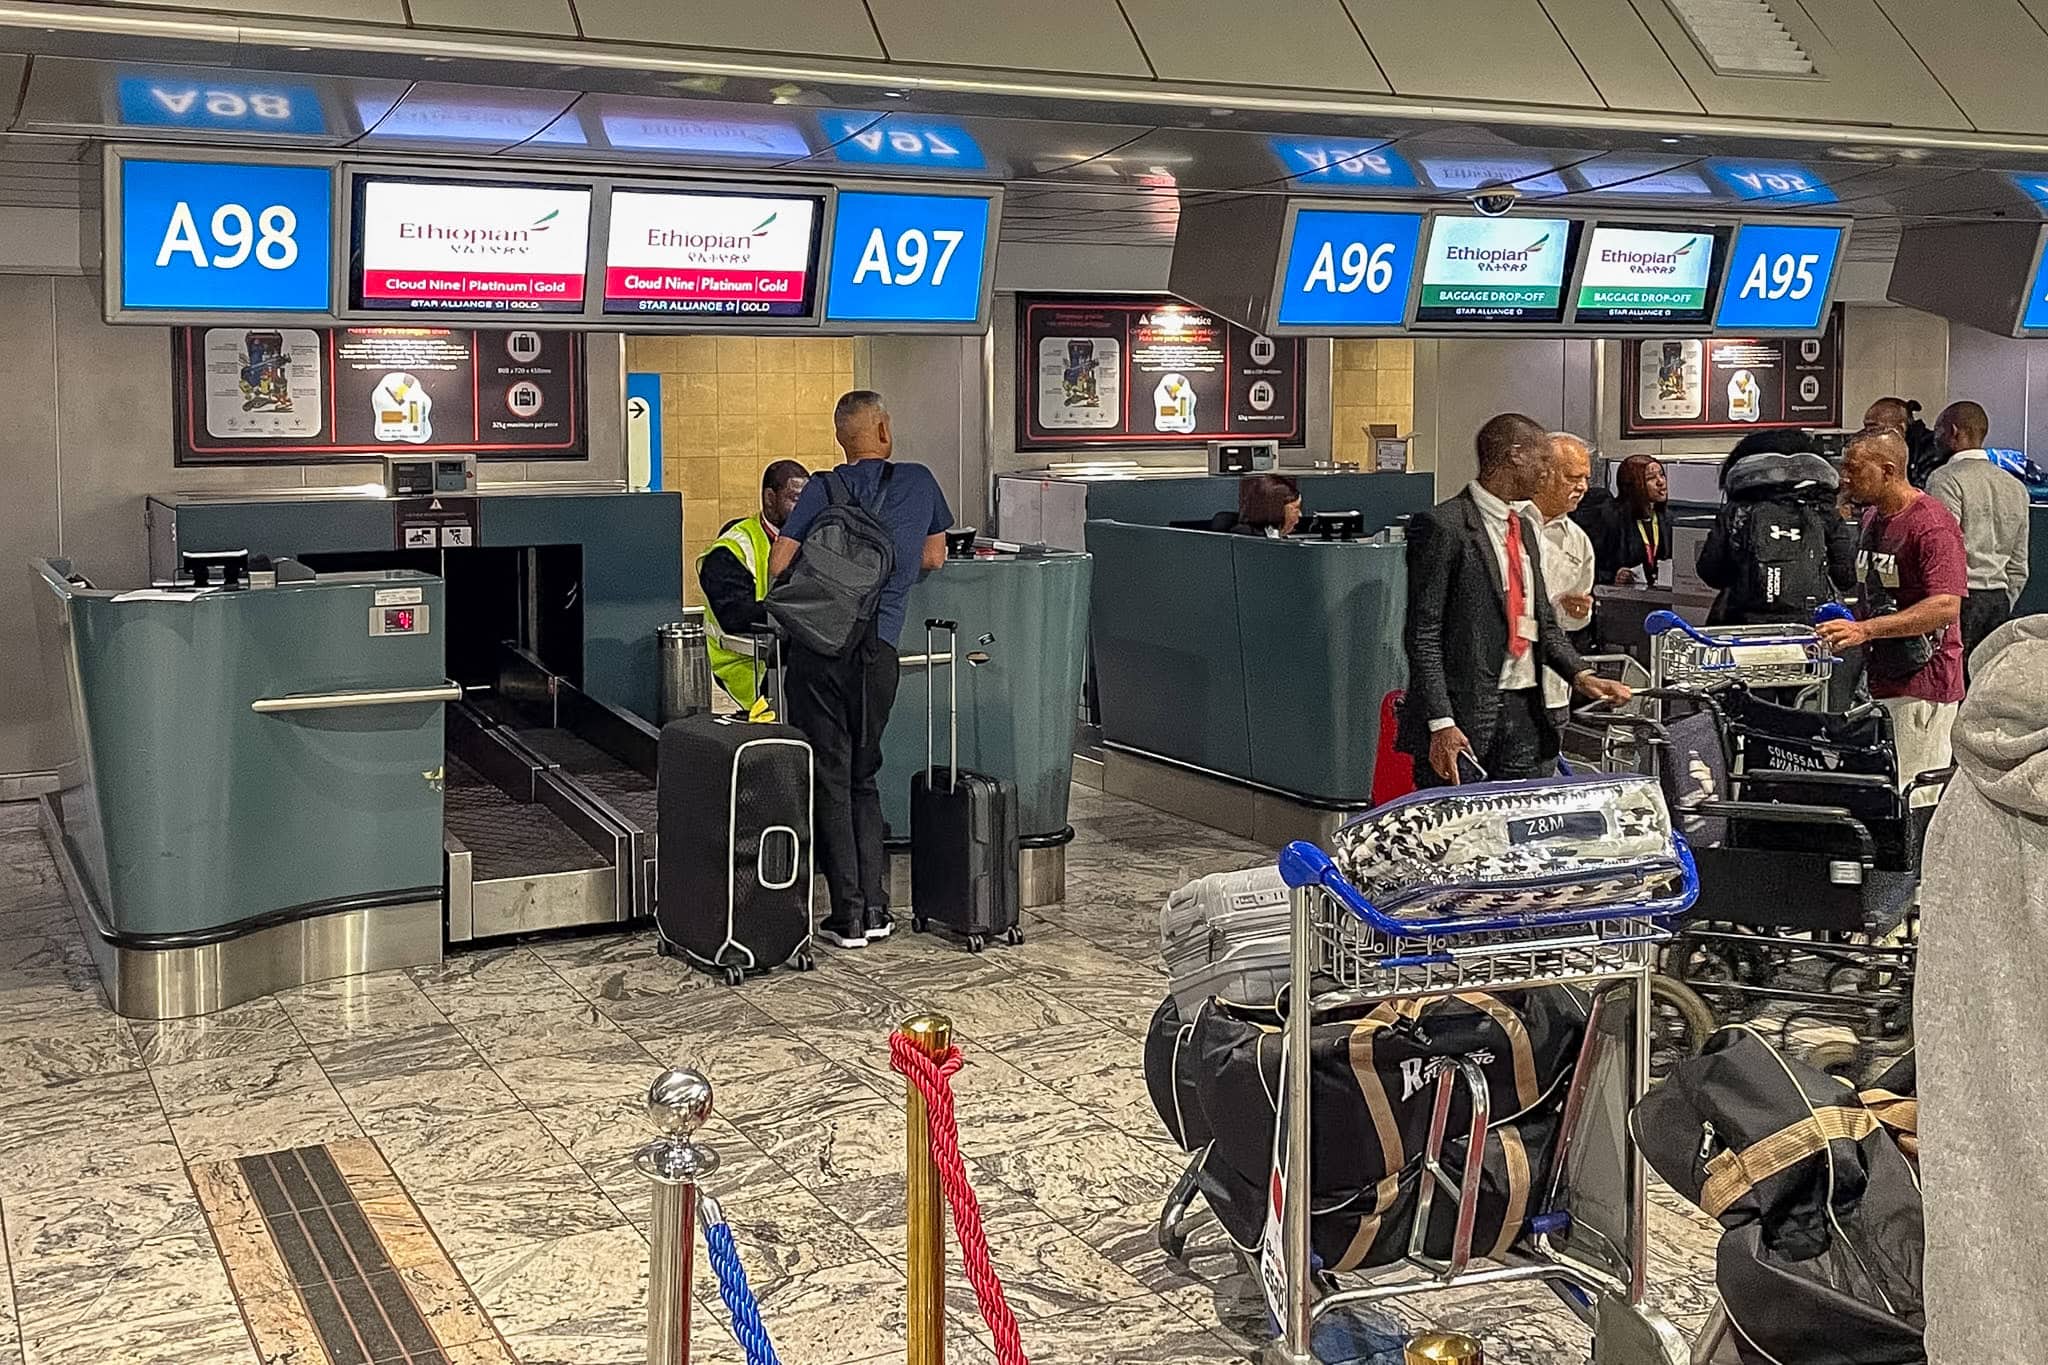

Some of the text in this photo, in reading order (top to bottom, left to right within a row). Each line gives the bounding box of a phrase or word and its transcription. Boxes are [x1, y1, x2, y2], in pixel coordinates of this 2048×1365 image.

[156, 201, 298, 270] A98
[399, 222, 529, 244] Ethiopian
[647, 228, 751, 252] Ethiopian
[852, 226, 965, 286] A97
[1446, 246, 1528, 262] Ethiopian
[1601, 249, 1677, 266] Ethiopian
[1303, 240, 1396, 294] A96
[1738, 252, 1820, 301] A95
[385, 278, 566, 292] Cloud Nine Platinum Gold
[624, 275, 788, 292] Cloud Nine Platinum Gold
[410, 300, 540, 309] STAR ALLIANCE GOLD
[1439, 291, 1545, 302] BAGGAGE DROP-OFF
[1593, 292, 1692, 303] BAGGAGE DROP-OFF
[638, 301, 770, 312] STAR ALLIANCE GOLD
[1767, 744, 1825, 770] COLOSSAL
[1525, 815, 1565, 836] Z&M
